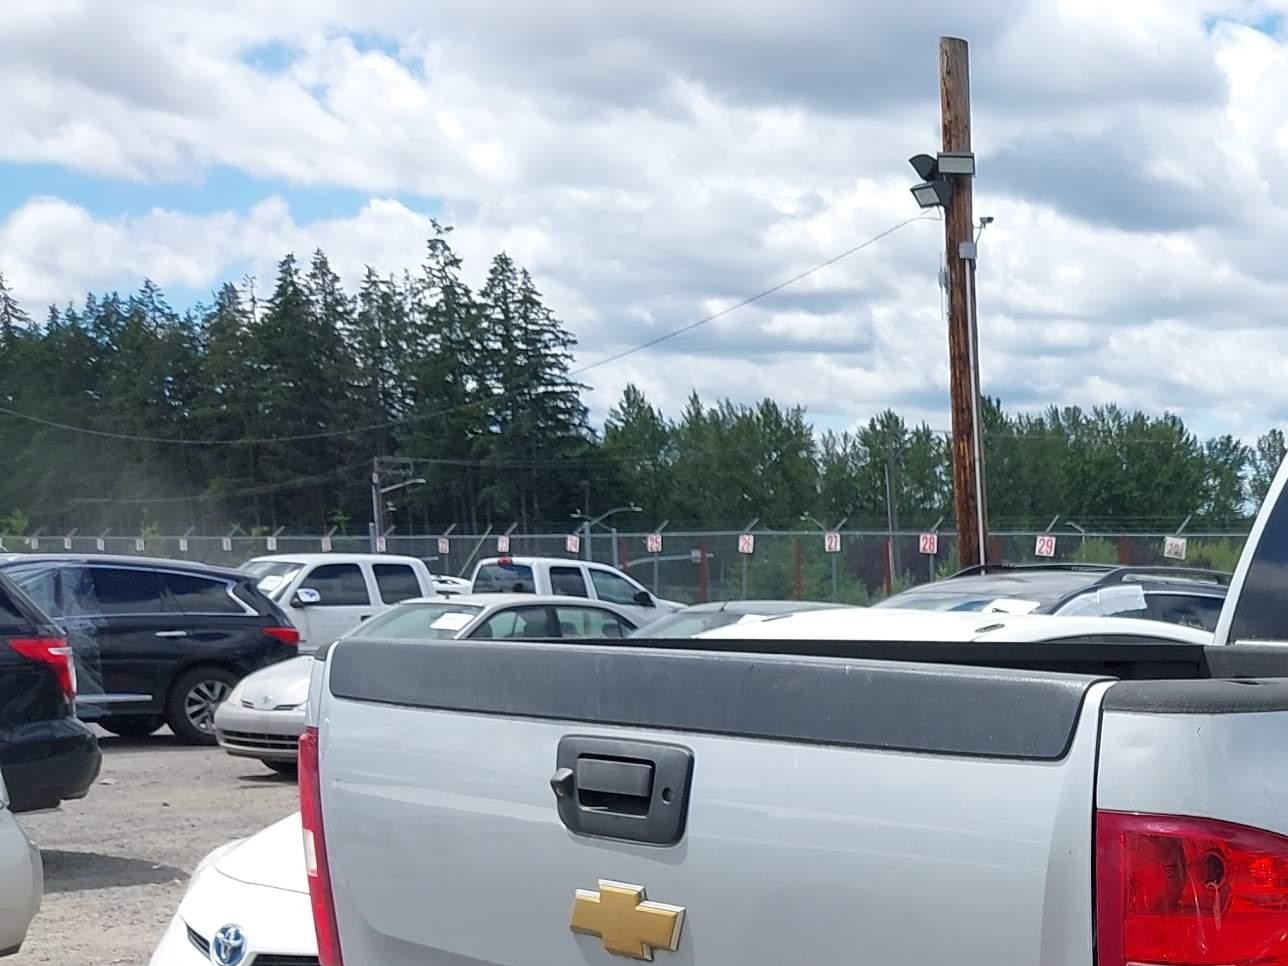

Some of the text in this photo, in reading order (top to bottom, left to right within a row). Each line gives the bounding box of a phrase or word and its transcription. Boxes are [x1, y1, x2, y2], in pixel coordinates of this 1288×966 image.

[649, 536, 660, 550] 25
[742, 536, 751, 551] 26
[827, 535, 838, 550] 27
[922, 536, 935, 552] 28
[1038, 537, 1053, 555] 29
